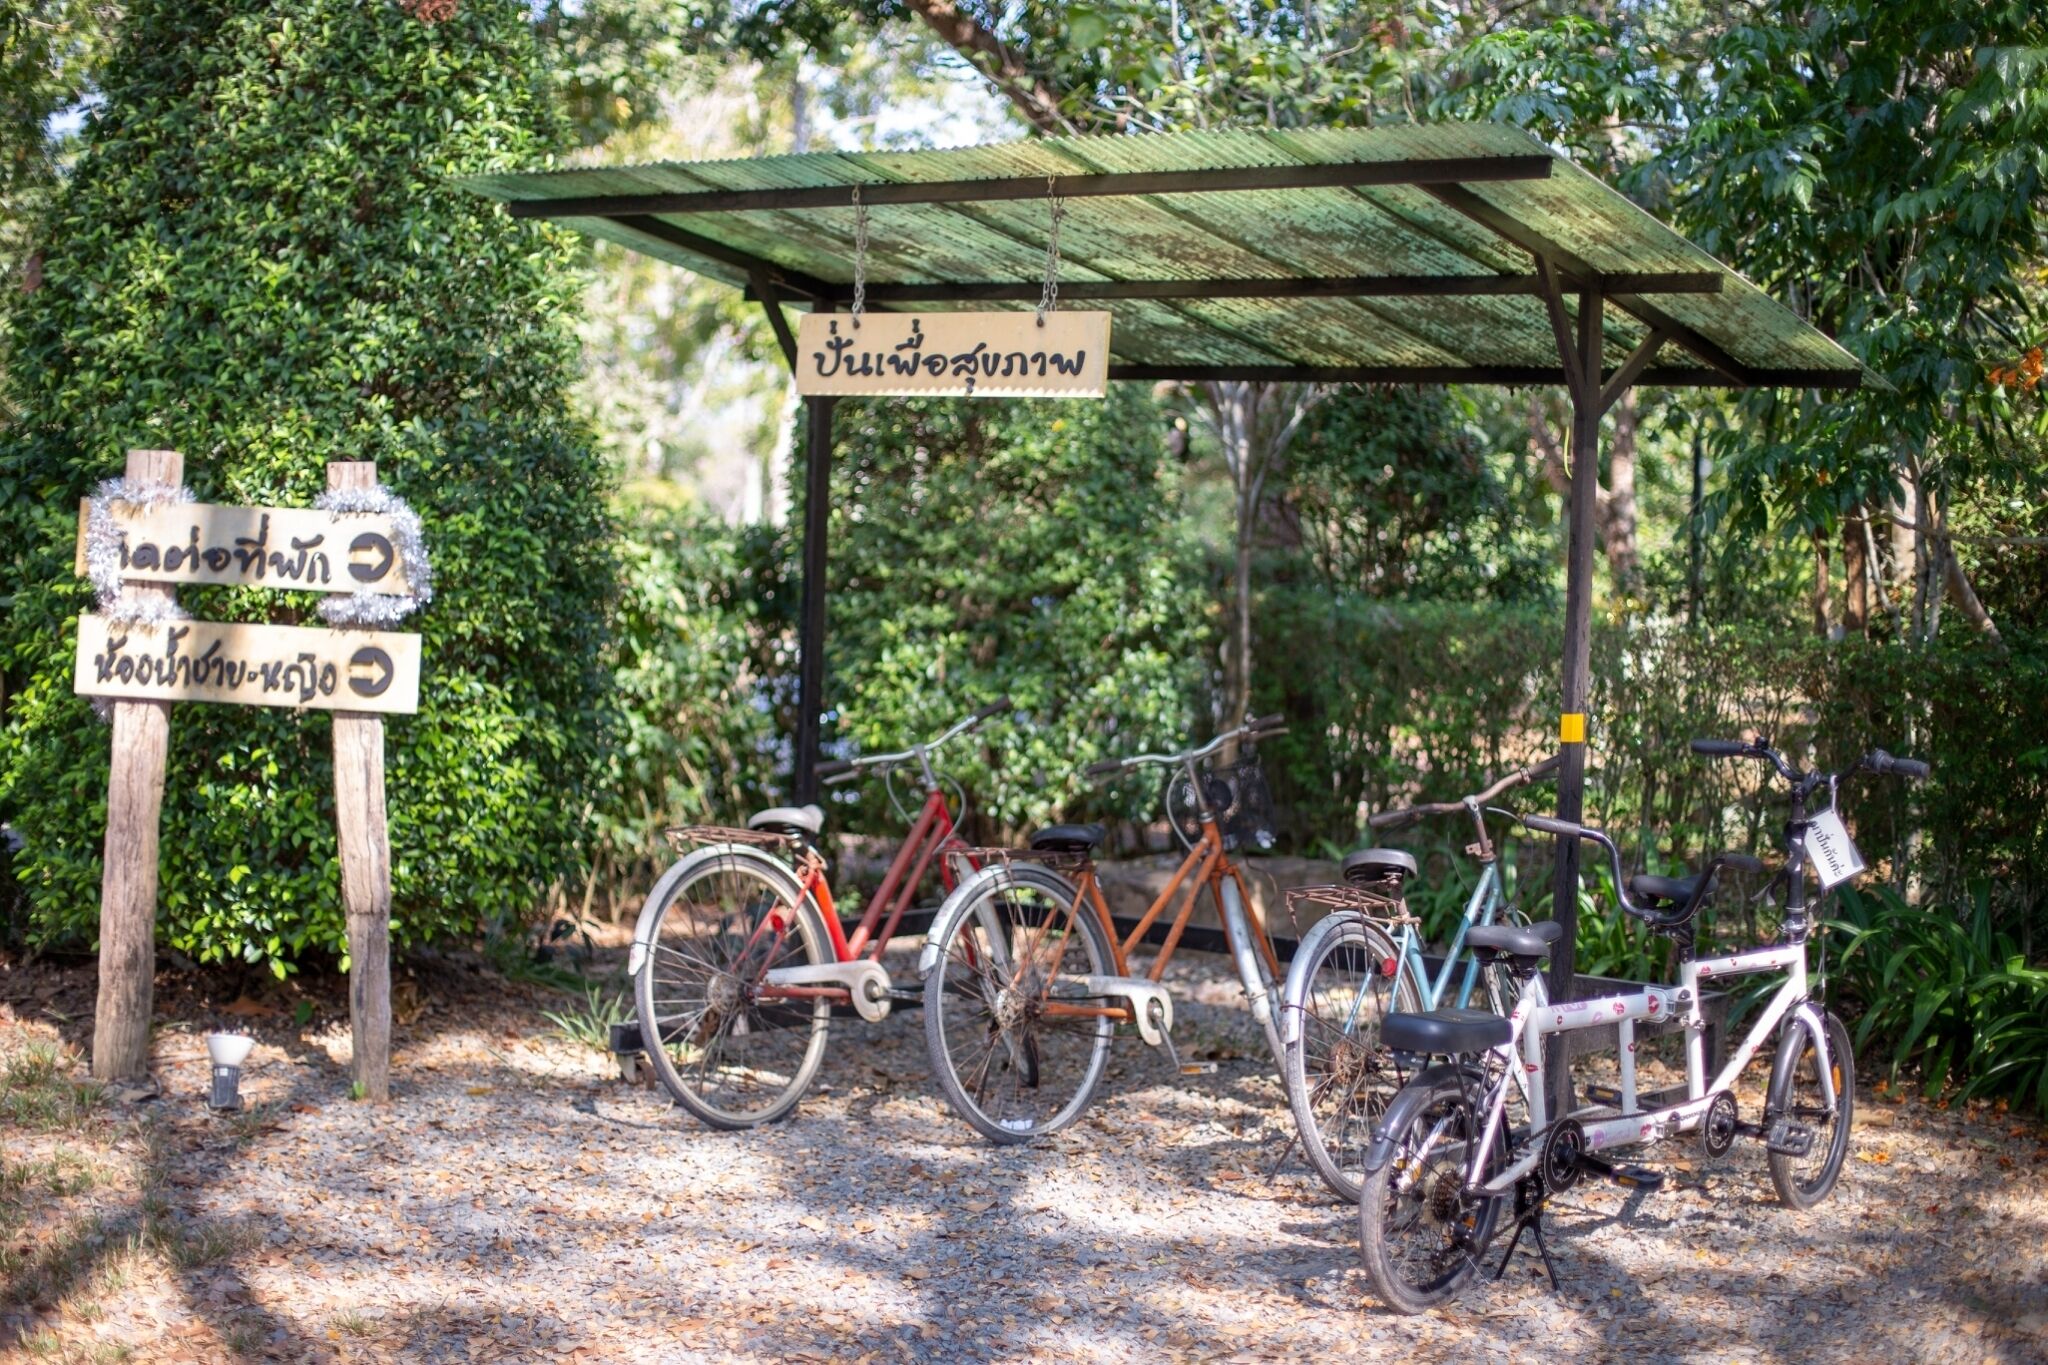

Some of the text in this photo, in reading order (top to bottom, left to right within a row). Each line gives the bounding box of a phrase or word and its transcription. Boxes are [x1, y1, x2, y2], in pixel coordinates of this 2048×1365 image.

[813, 318, 1086, 394] ปั่นเพื่อสุขภาพ
